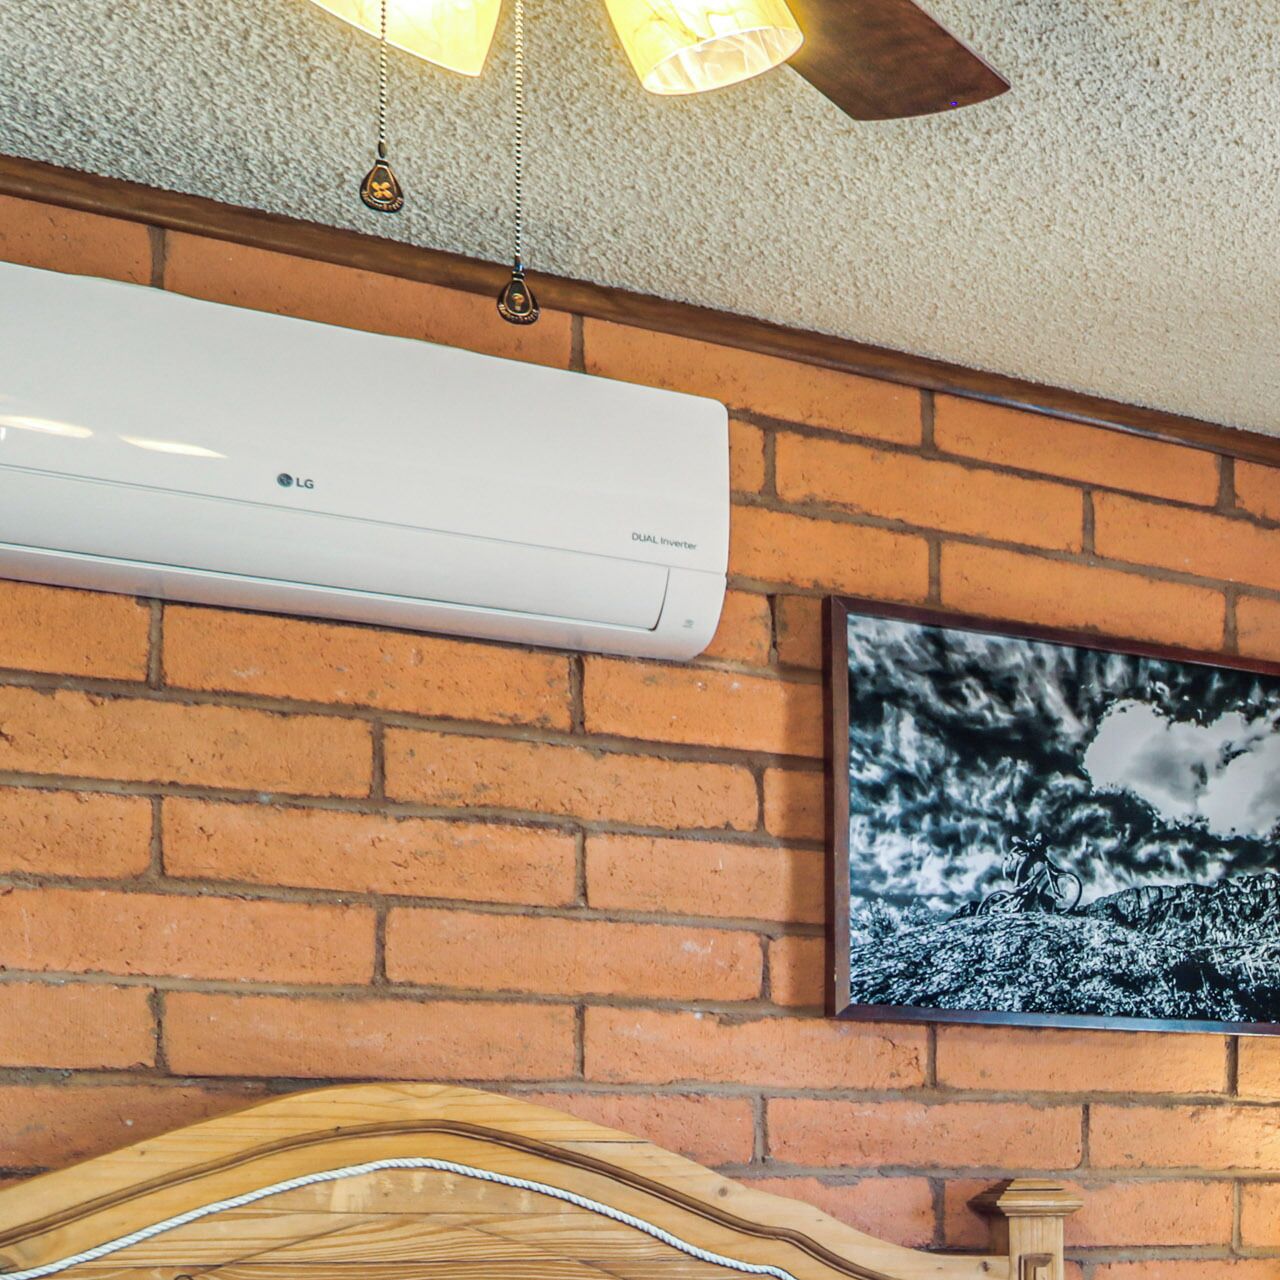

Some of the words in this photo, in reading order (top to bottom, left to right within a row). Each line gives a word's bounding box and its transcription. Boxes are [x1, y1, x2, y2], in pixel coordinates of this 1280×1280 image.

[296, 477, 314, 489] LG
[631, 532, 659, 544] DUAL
[660, 537, 697, 550] Inverter
